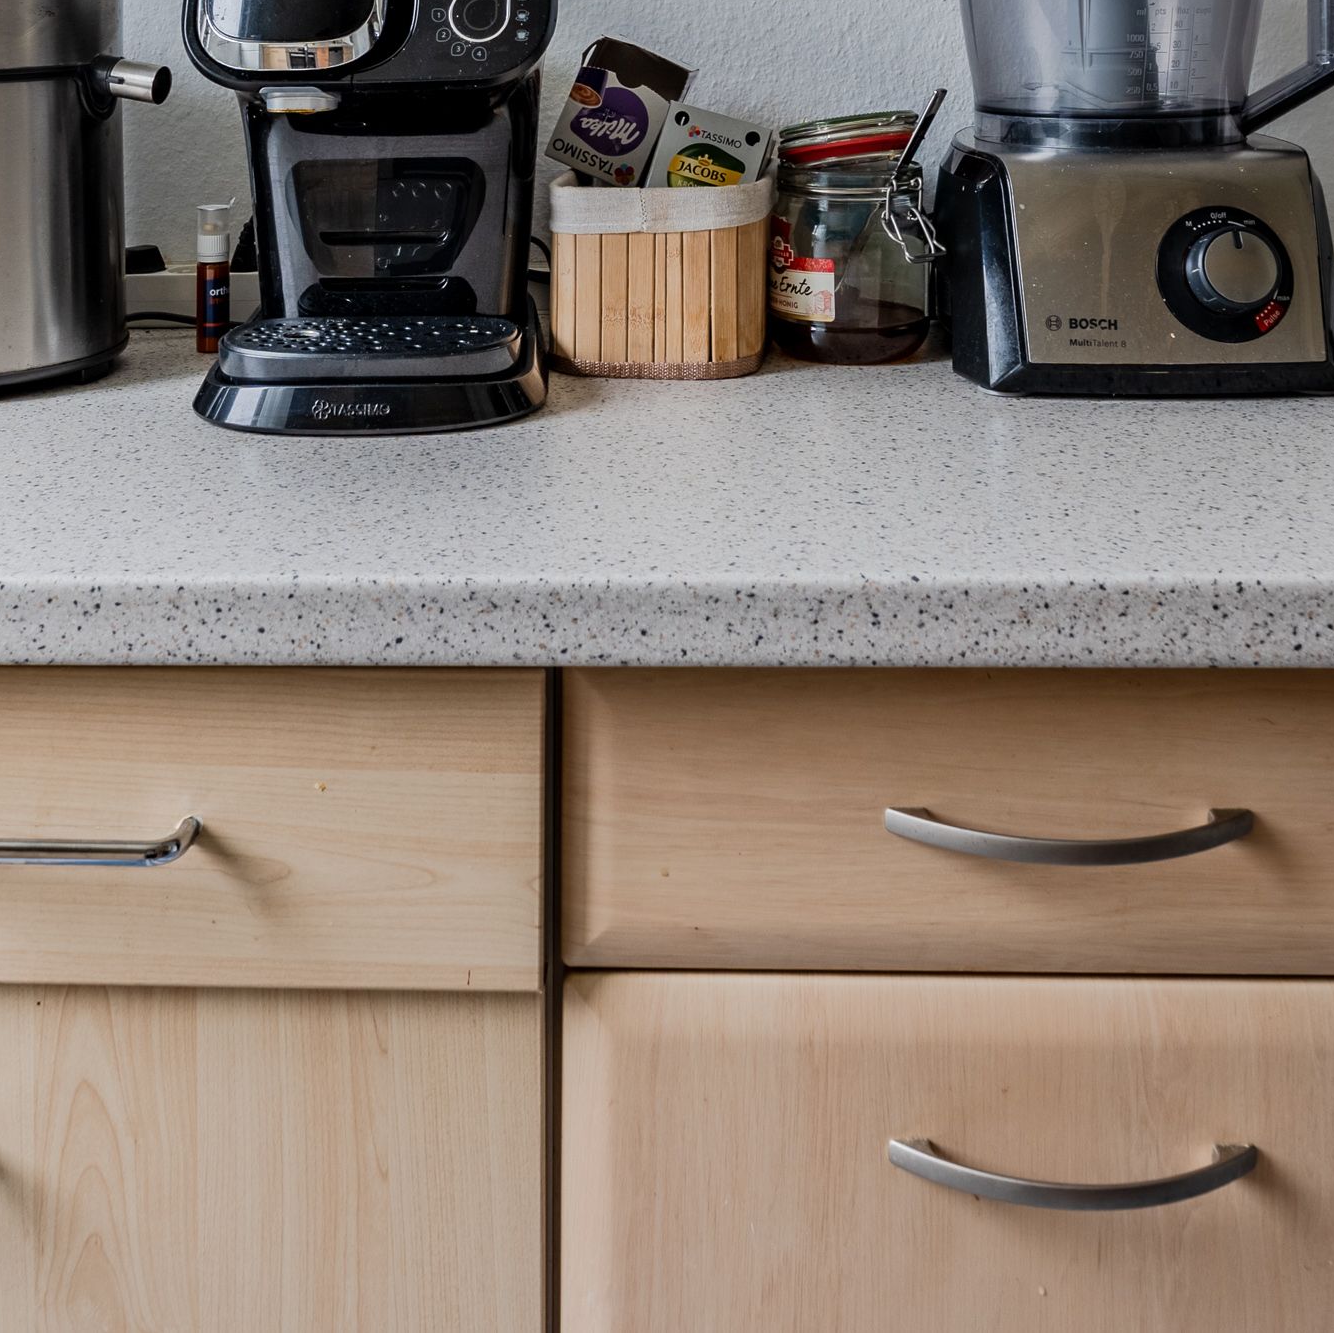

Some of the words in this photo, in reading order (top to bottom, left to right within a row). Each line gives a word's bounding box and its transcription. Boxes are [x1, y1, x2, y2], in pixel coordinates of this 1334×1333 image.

[579, 117, 640, 145] Milka
[701, 129, 742, 149] TASSIMO
[552, 138, 615, 177] TASSIMO
[677, 160, 727, 183] JACOBS
[779, 276, 813, 296] Ernte
[1069, 318, 1118, 330] BOSCH
[1263, 310, 1281, 327] Pulse
[1069, 338, 1119, 348] MultiTalent
[1121, 340, 1127, 348] 8
[330, 403, 391, 416] TASSIMO
